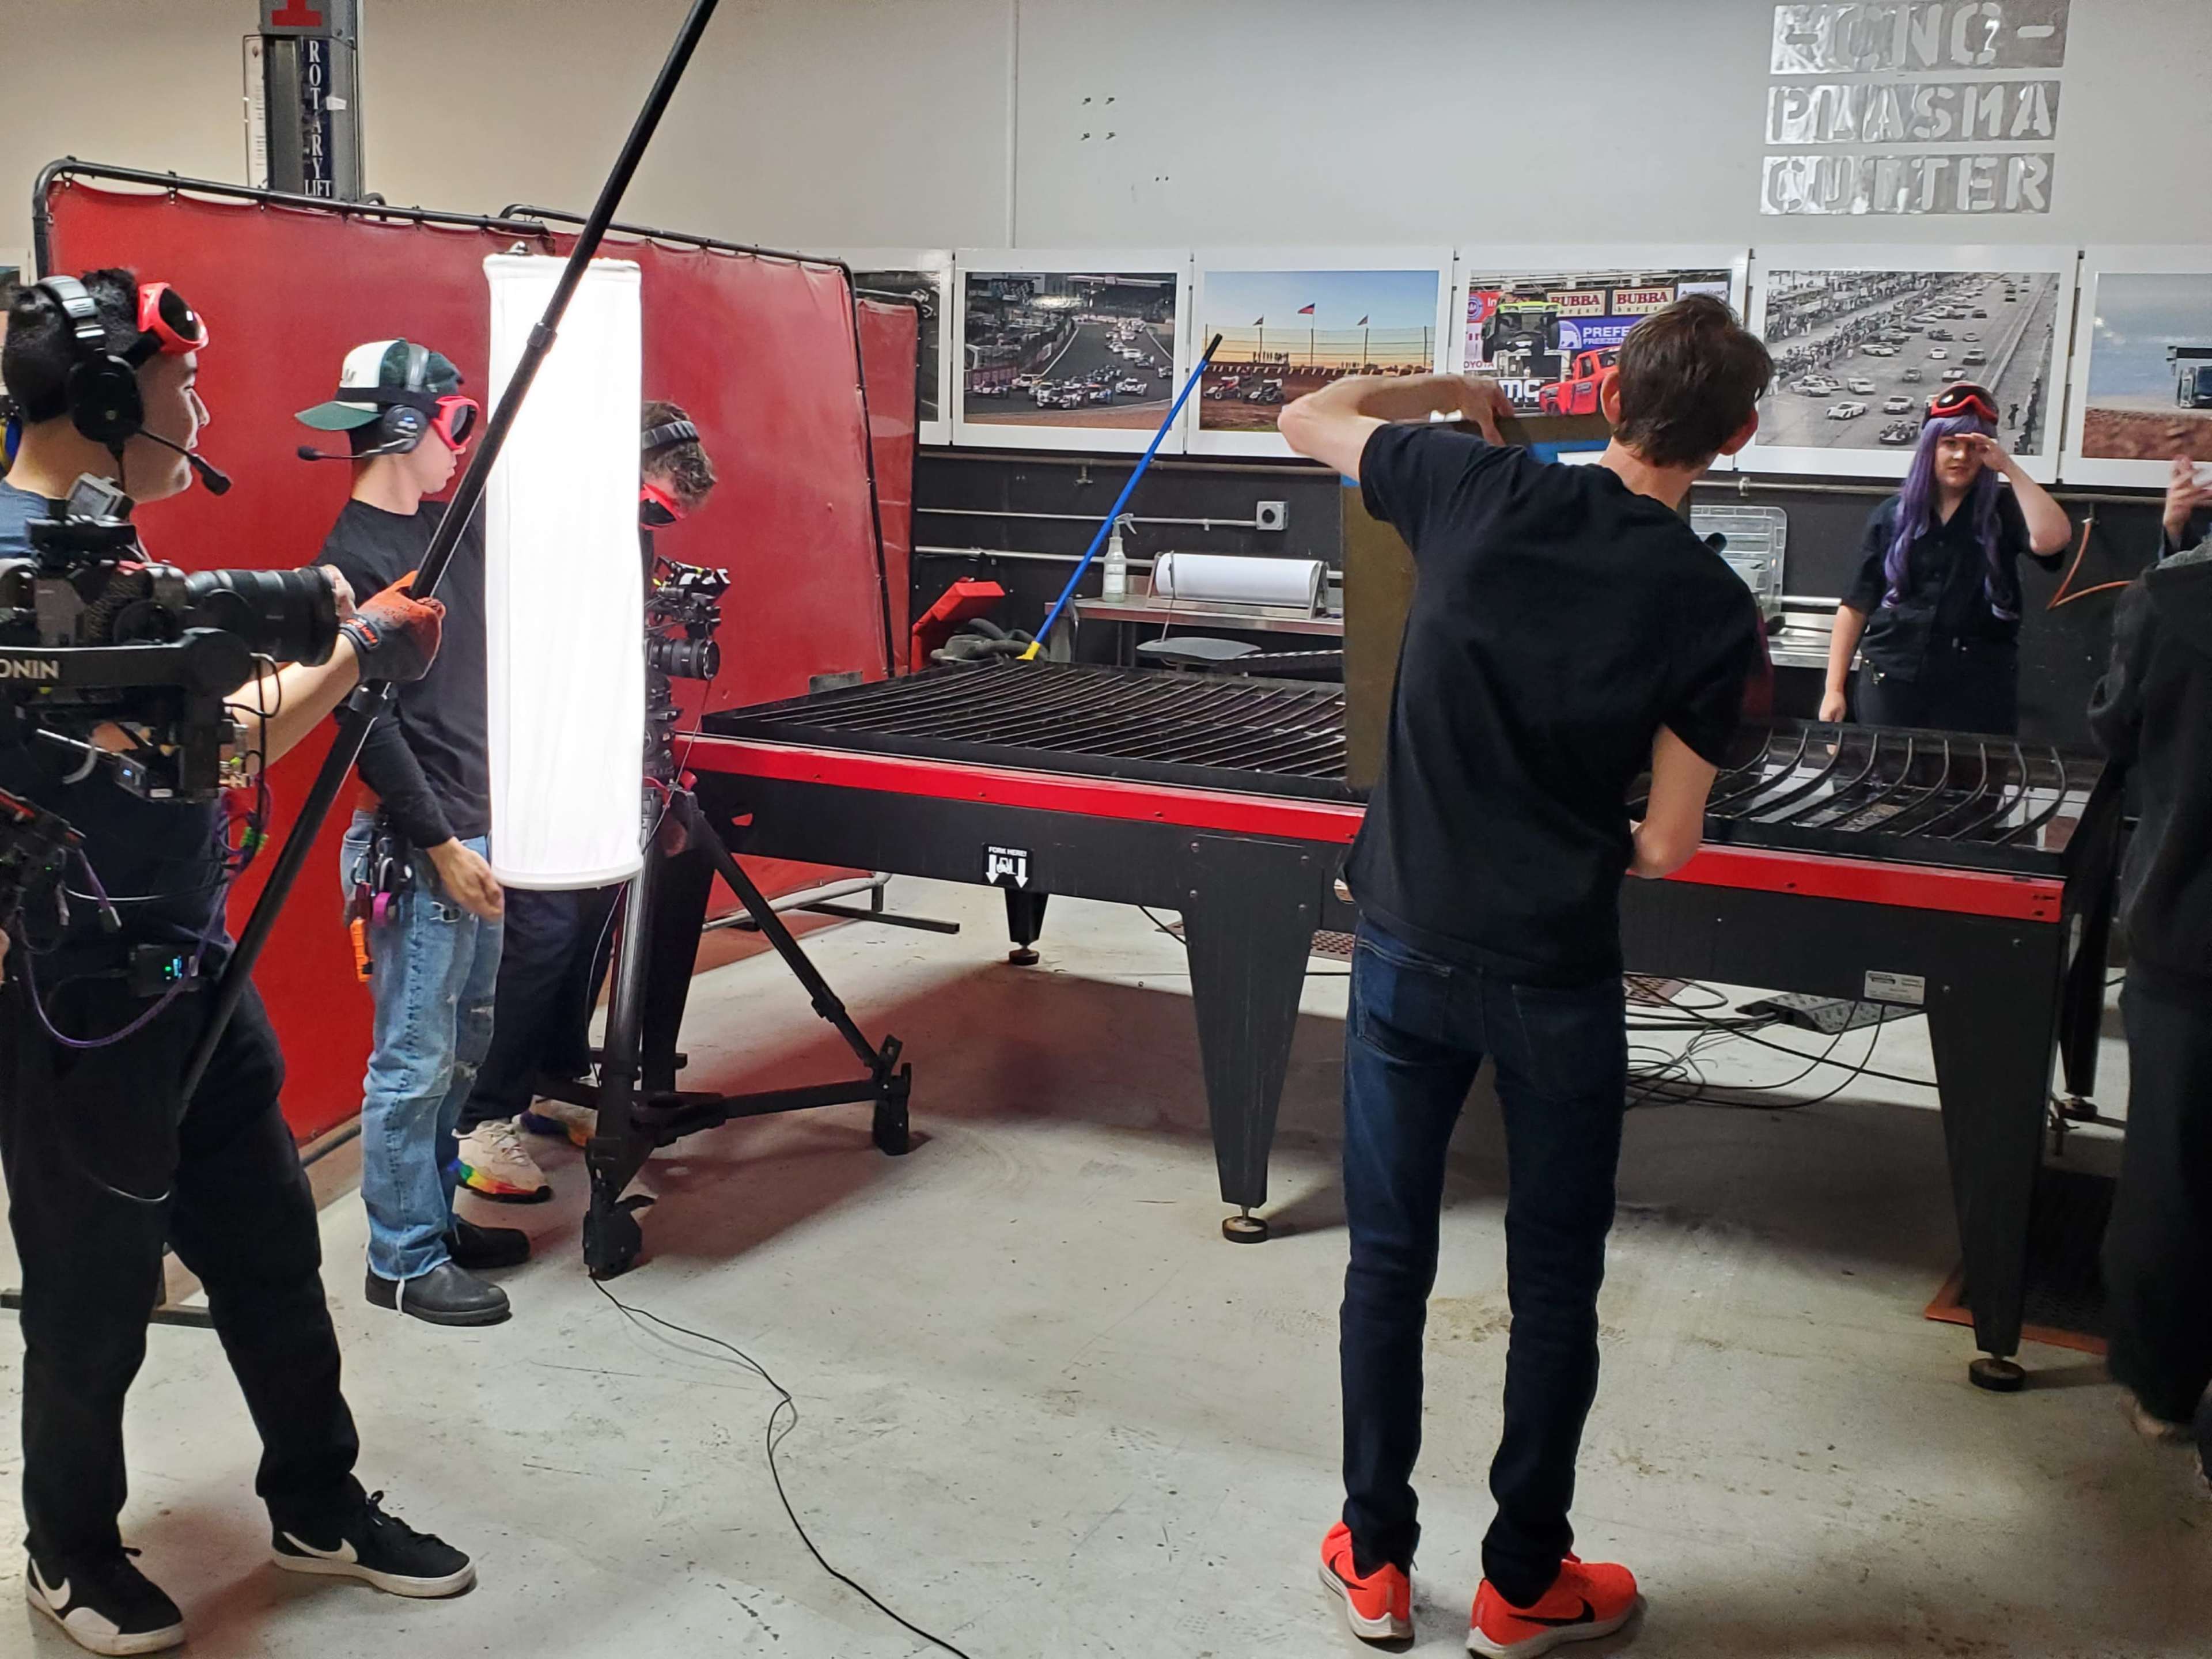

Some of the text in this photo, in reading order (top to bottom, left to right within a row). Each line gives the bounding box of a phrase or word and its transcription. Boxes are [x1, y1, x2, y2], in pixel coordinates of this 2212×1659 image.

[309, 40, 323, 179] ROTARY
[1772, 84, 2052, 142] PLASMA
[304, 180, 332, 196] LIFT
[1767, 157, 2048, 211] CUTTER
[1617, 291, 1669, 305] BUBBA
[988, 846, 1006, 855] FORK
